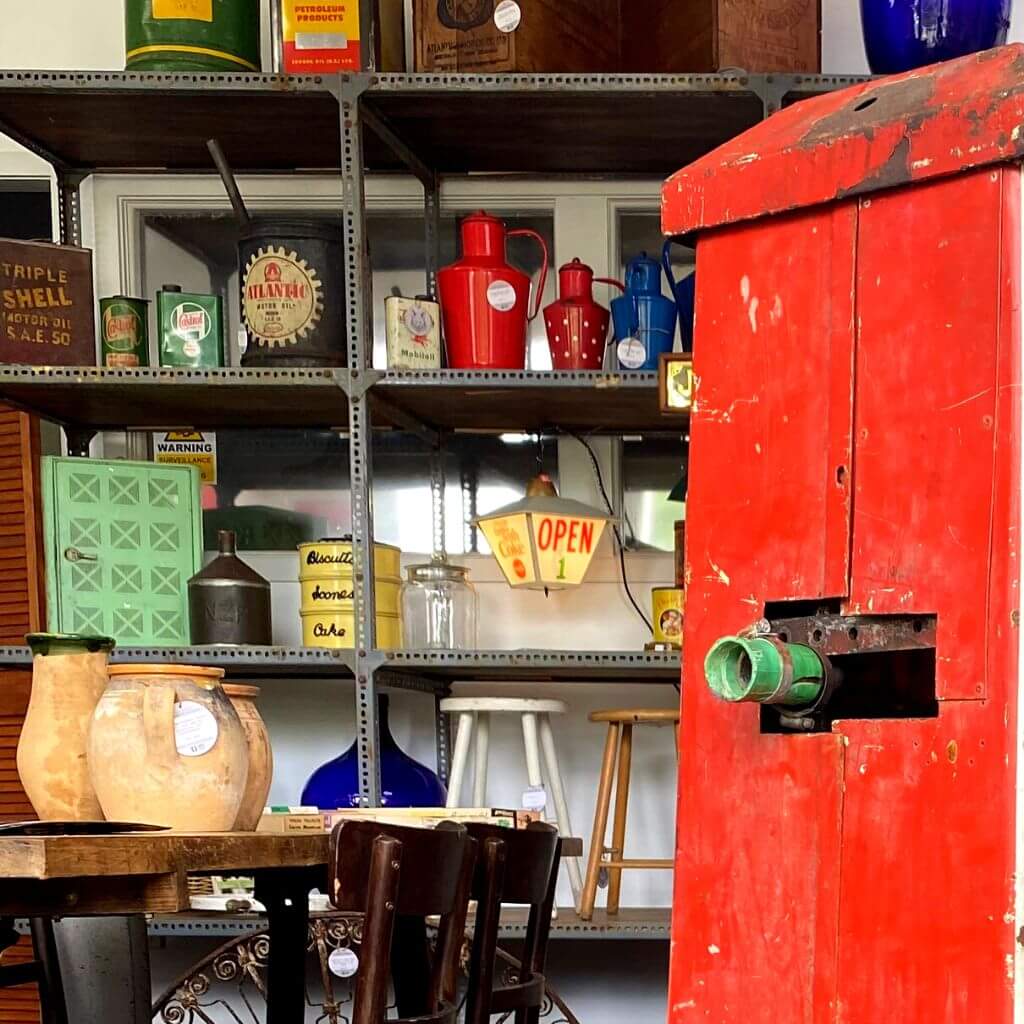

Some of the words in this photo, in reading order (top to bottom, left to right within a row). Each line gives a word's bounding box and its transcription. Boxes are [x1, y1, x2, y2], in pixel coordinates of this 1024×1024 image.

[2, 263, 68, 284] TRIPLE
[3, 287, 73, 309] SHELL
[2, 311, 48, 327] MOTOR
[52, 317, 72, 330] OIL
[52, 330, 71, 346] 50
[158, 443, 212, 453] WARNING
[537, 517, 594, 554] OPEN
[556, 558, 566, 580] 1
[313, 622, 346, 638] Cake
